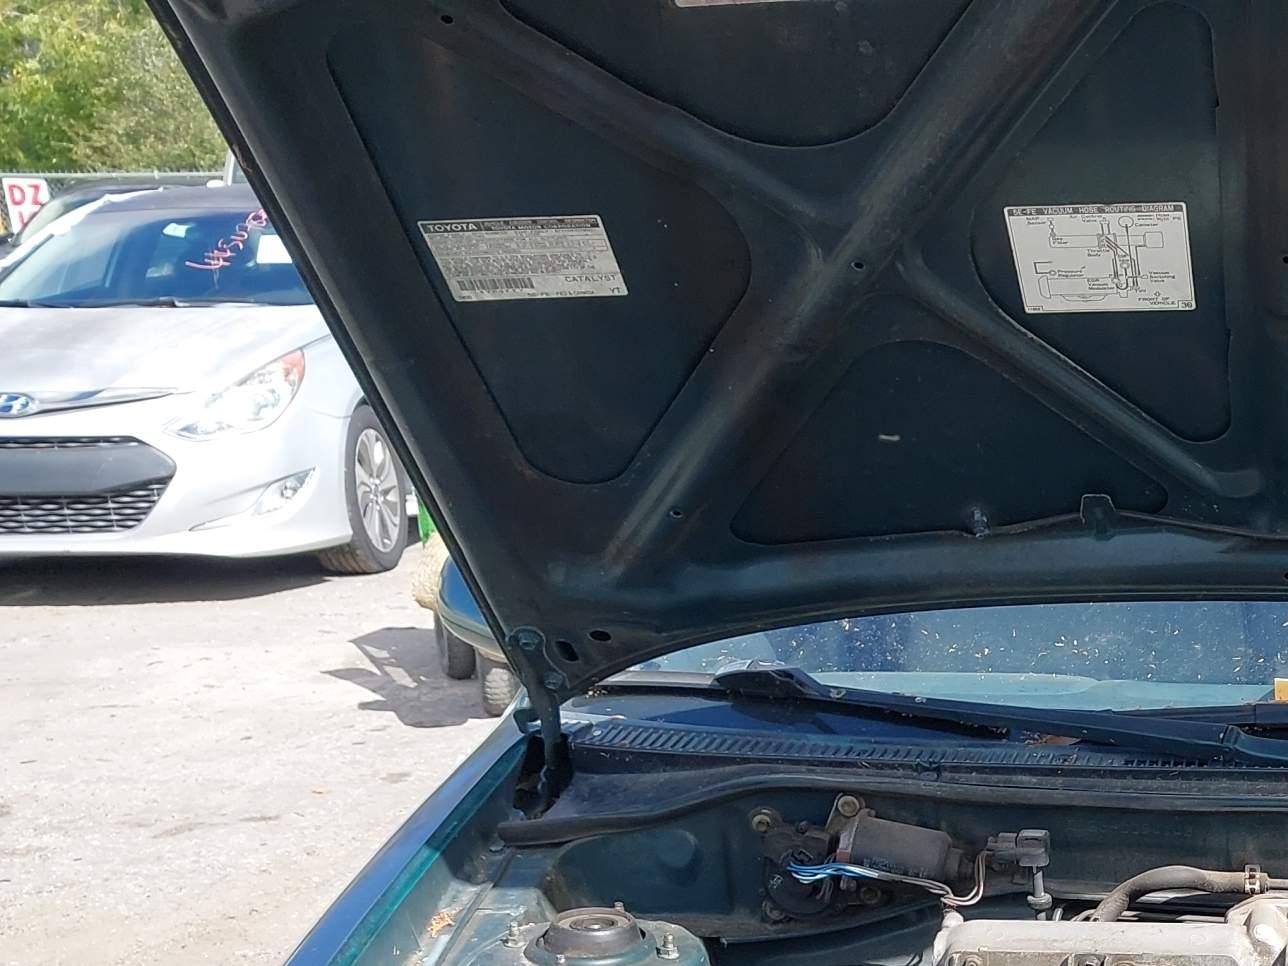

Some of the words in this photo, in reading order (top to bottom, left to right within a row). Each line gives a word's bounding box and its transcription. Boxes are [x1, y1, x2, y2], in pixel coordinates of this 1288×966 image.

[1042, 206, 1073, 215] VACUUM
[1078, 205, 1099, 214] HOSE
[1104, 204, 1137, 213] ROUTING
[1141, 203, 1175, 213] DIAGRAM
[427, 222, 478, 232] TOYOTA
[564, 274, 617, 283] CATALYST
